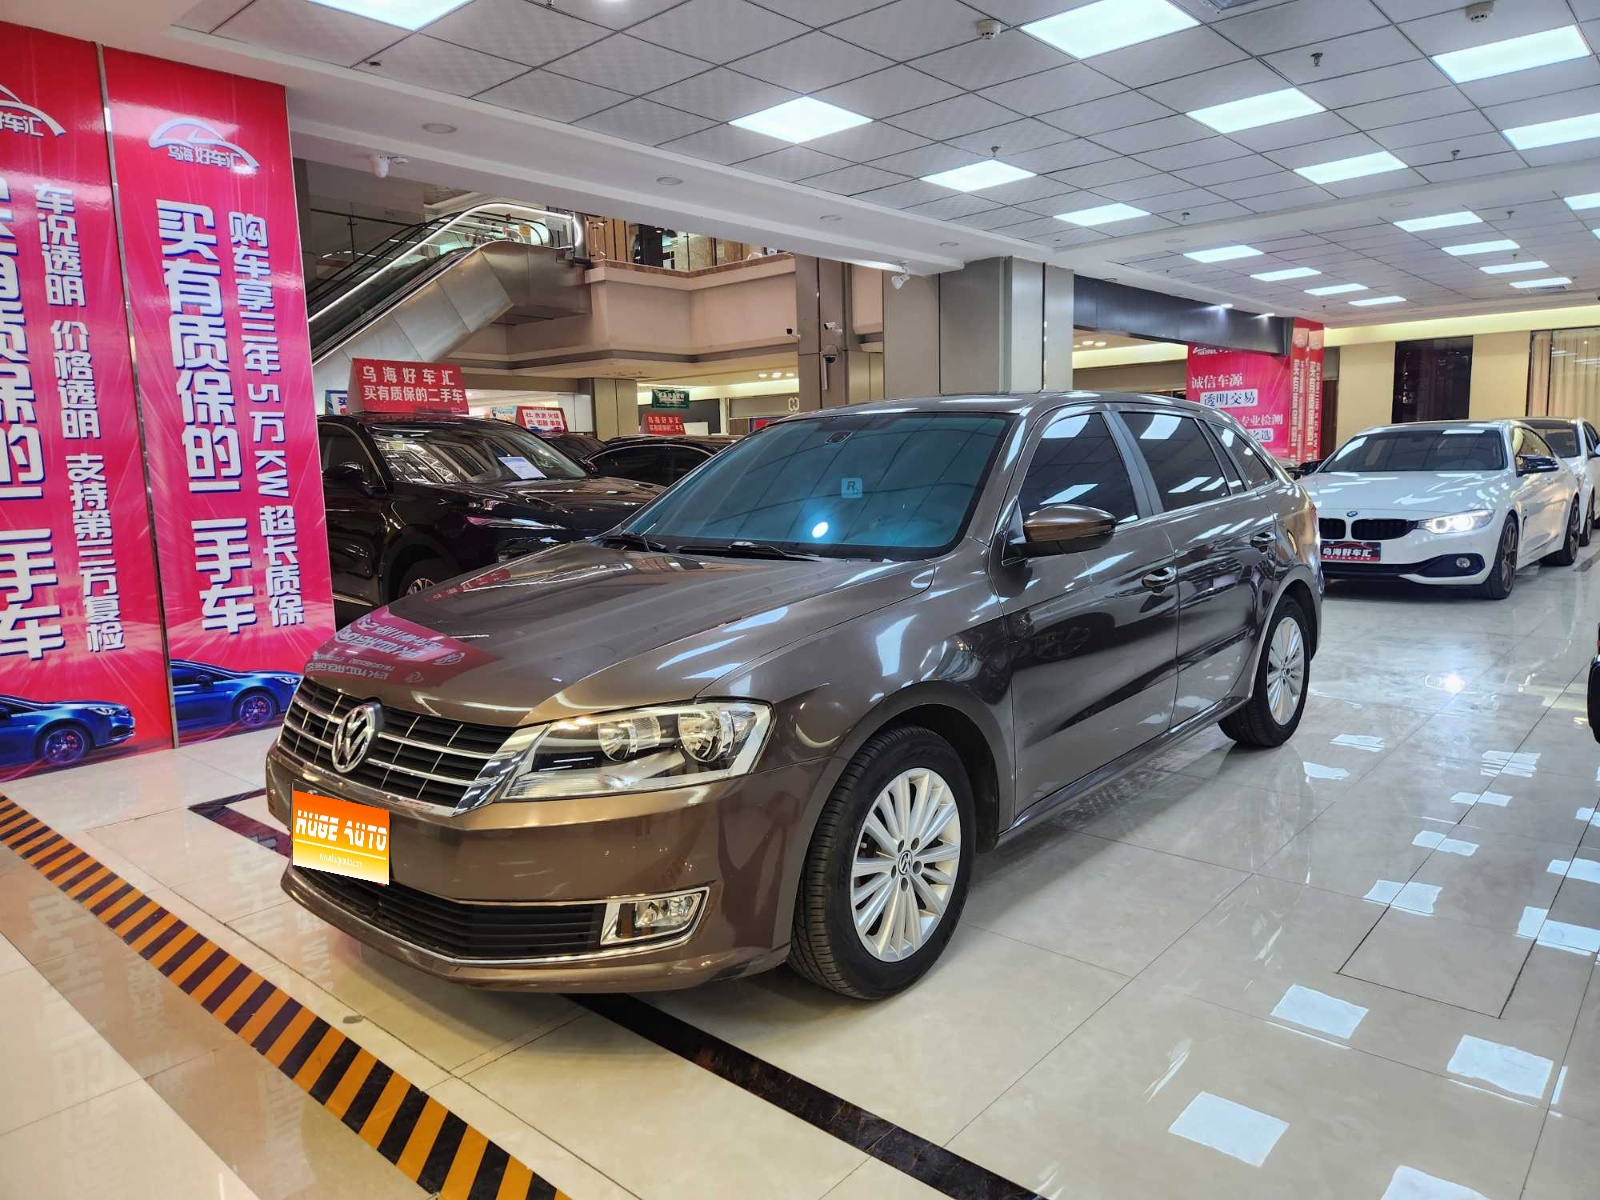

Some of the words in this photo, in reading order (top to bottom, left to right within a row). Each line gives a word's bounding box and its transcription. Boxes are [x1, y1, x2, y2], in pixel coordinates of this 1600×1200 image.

[0, 112, 44, 137] 车汇
[34, 183, 85, 307] 车况透明
[50, 319, 101, 440] 价格透明
[362, 365, 455, 386] 乌海好车汇
[1191, 372, 1243, 390] 诚信车源
[363, 384, 464, 404] 买有质保的二手车
[1204, 391, 1256, 407] 透明交易
[155, 198, 258, 635] 买有质保的二手车
[65, 452, 125, 652] 支持第三方复检
[1322, 547, 1373, 558] 乌海好车汇
